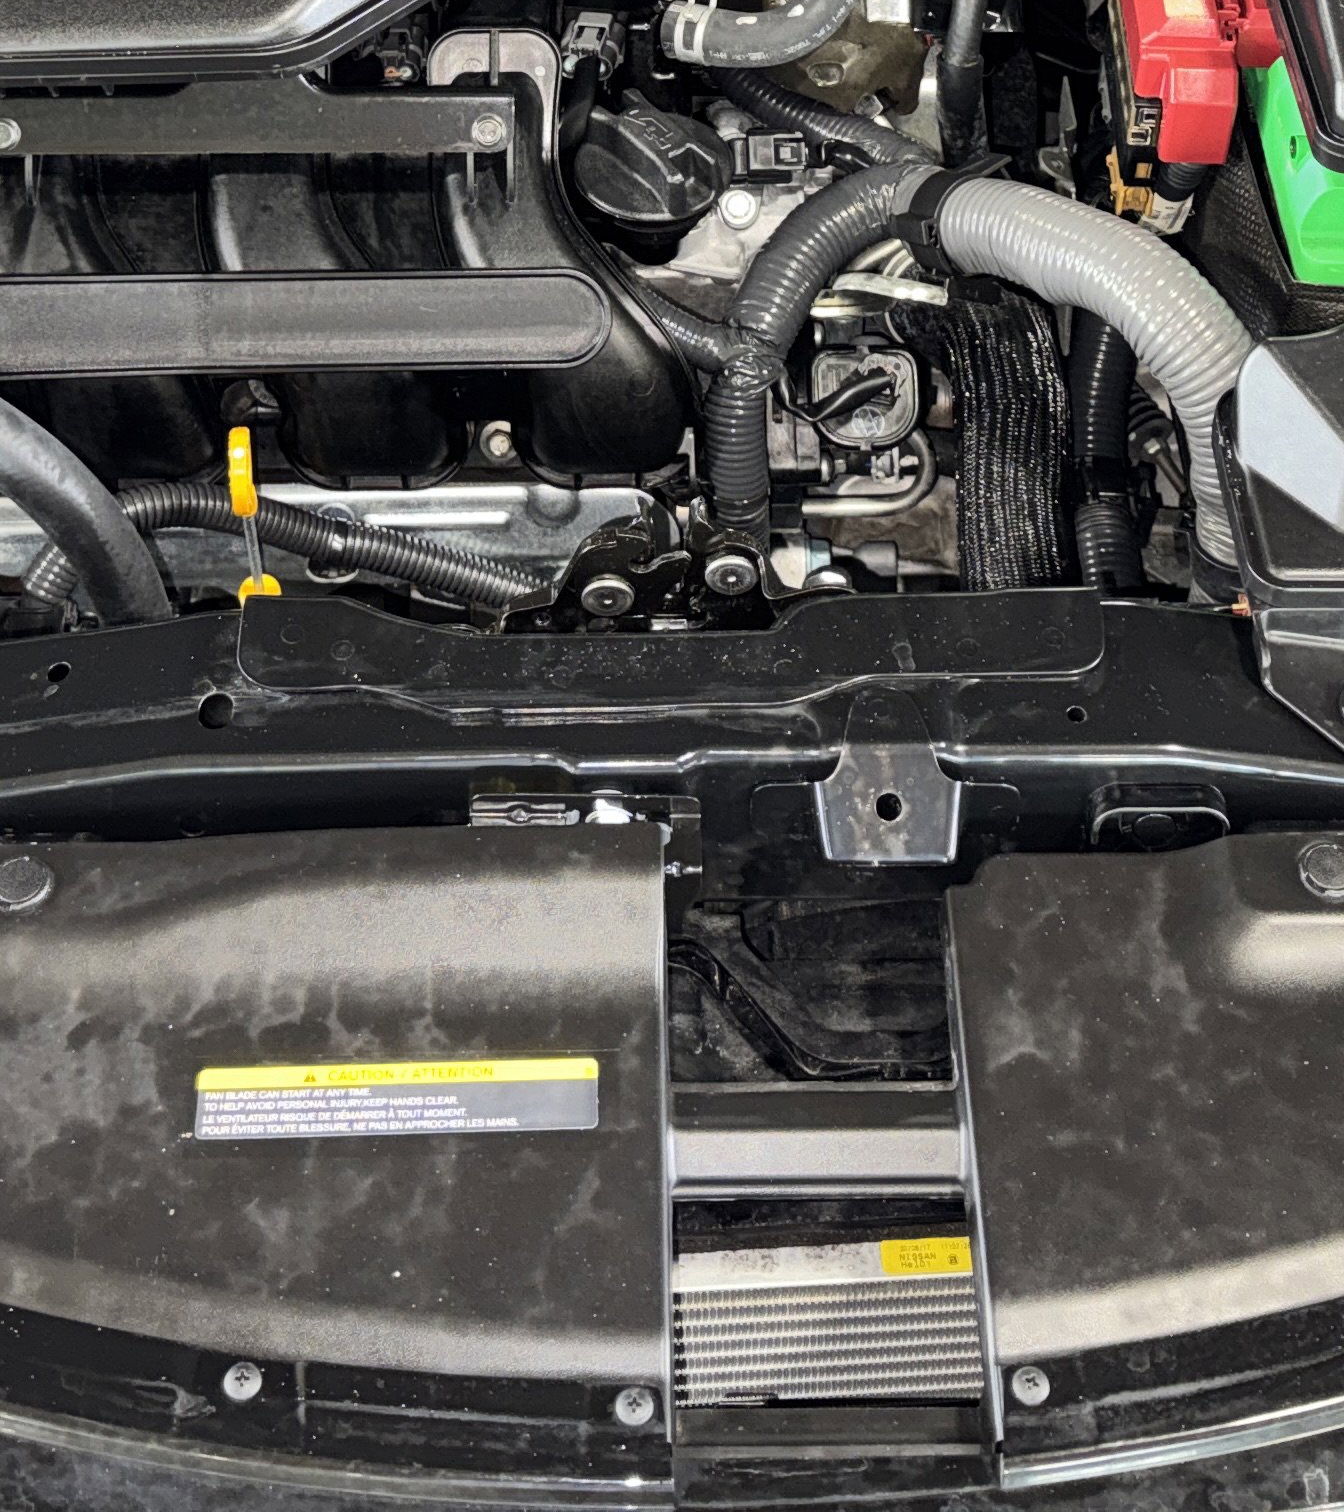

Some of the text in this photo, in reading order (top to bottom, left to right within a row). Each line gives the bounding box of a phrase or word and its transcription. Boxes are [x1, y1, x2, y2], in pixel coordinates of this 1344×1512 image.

[328, 1069, 395, 1081] CAUTION
[412, 1066, 493, 1079] ATTENTION
[205, 1087, 373, 1100] FAN BLADE CAN START AT ANY TIME.
[204, 1102, 217, 1111] TO
[220, 1102, 244, 1110] HELP
[246, 1100, 275, 1110] AVOID
[277, 1099, 328, 1109] PERSONAL
[389, 1096, 424, 1106] HANDS
[203, 1114, 215, 1123] LE
[216, 1113, 278, 1123] VENTILATEUR
[280, 1112, 317, 1122] RISQUE
[318, 1111, 332, 1120] DE
[333, 1109, 386, 1120] DÉMARRER
[397, 1109, 422, 1118] TOUT
[423, 1107, 467, 1118] MOMENT.
[202, 1126, 230, 1135] POUR
[231, 1123, 264, 1135] ÉVITER
[265, 1124, 297, 1134] TOUTE
[353, 1121, 367, 1131] NE
[368, 1121, 388, 1131] PAS
[389, 1121, 403, 1130] EN
[405, 1118, 466, 1130] APPROCHER
[466, 1118, 485, 1127] LES
[899, 1252, 936, 1261] NISSAN
